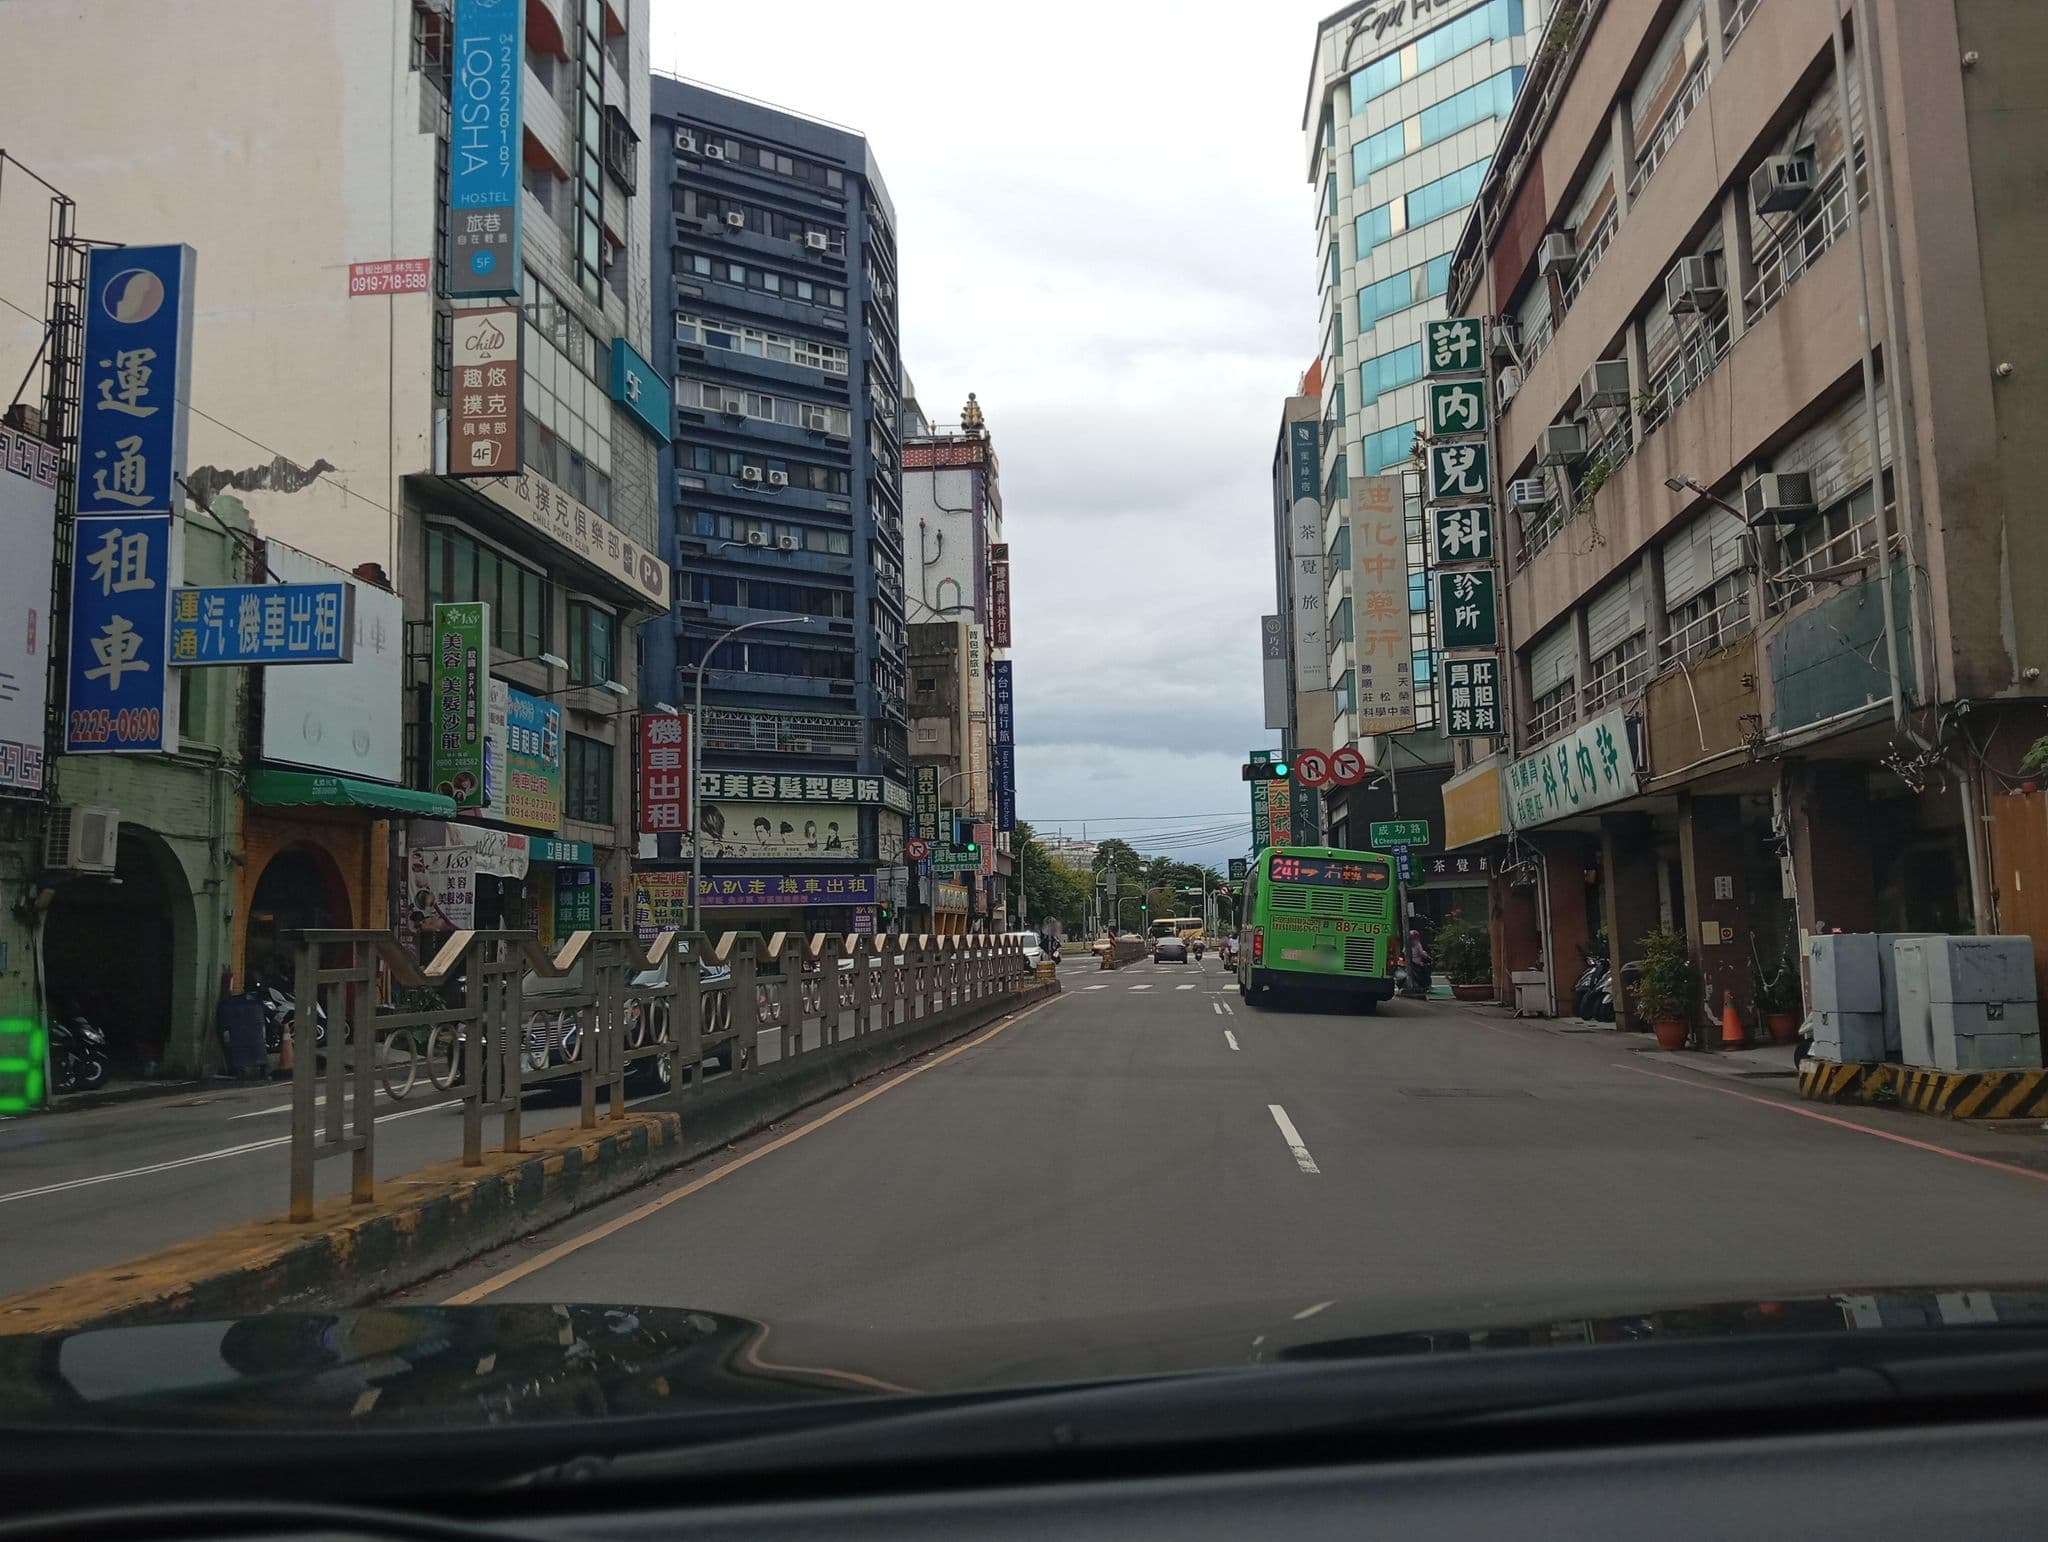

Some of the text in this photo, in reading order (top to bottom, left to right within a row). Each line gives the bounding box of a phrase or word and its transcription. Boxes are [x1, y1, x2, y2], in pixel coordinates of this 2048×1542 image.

[461, 36, 493, 176] LOOSHA
[499, 47, 512, 177] 22228187
[461, 191, 510, 204] HOSTEL
[466, 213, 502, 233] 旅巷
[396, 263, 424, 272] 林先生
[476, 256, 491, 269] 5F
[465, 328, 505, 351] Chill
[463, 367, 507, 388] 趣悠
[626, 370, 642, 402] 5F
[463, 393, 507, 415] 撲克
[463, 422, 507, 436] 俱樂部
[473, 448, 490, 460] 4F
[532, 511, 551, 532] CHILL
[1299, 523, 1319, 610] 茶覺旅
[174, 591, 199, 659] 運通
[442, 633, 462, 668] 美容
[1450, 664, 1472, 731] 胃腸科
[70, 708, 160, 743] 2225-0698
[512, 769, 549, 795] 機車出租
[647, 719, 682, 829] 機車出租
[1378, 823, 1421, 835] 成功路
[447, 876, 466, 889] 美容
[777, 879, 869, 894] 機車出租
[577, 891, 591, 921] 出租
[1336, 920, 1381, 934] 887-U5
